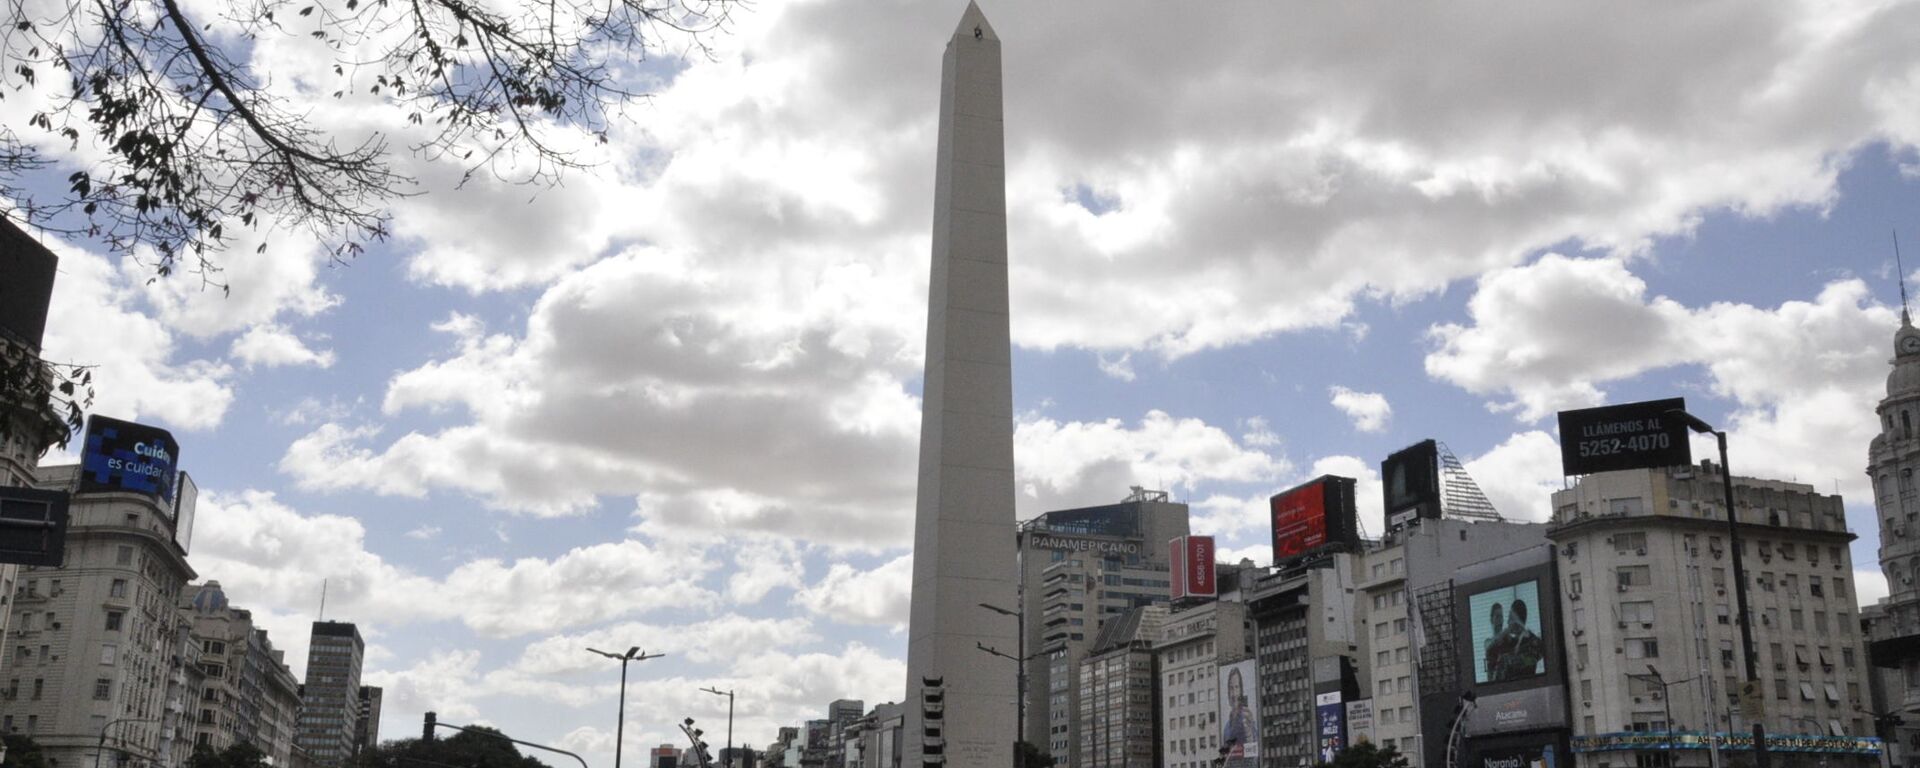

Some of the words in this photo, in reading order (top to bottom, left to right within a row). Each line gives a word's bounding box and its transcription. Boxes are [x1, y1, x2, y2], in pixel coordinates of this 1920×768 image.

[1583, 420, 1644, 437] LLÁMENOS
[1648, 418, 1662, 430] AL
[1579, 432, 1670, 457] 5252-4070
[108, 457, 122, 470] es
[1031, 536, 1137, 554] PANAMERICANO
[1697, 736, 1728, 745] AHRA
[1728, 736, 1755, 746] PODE
